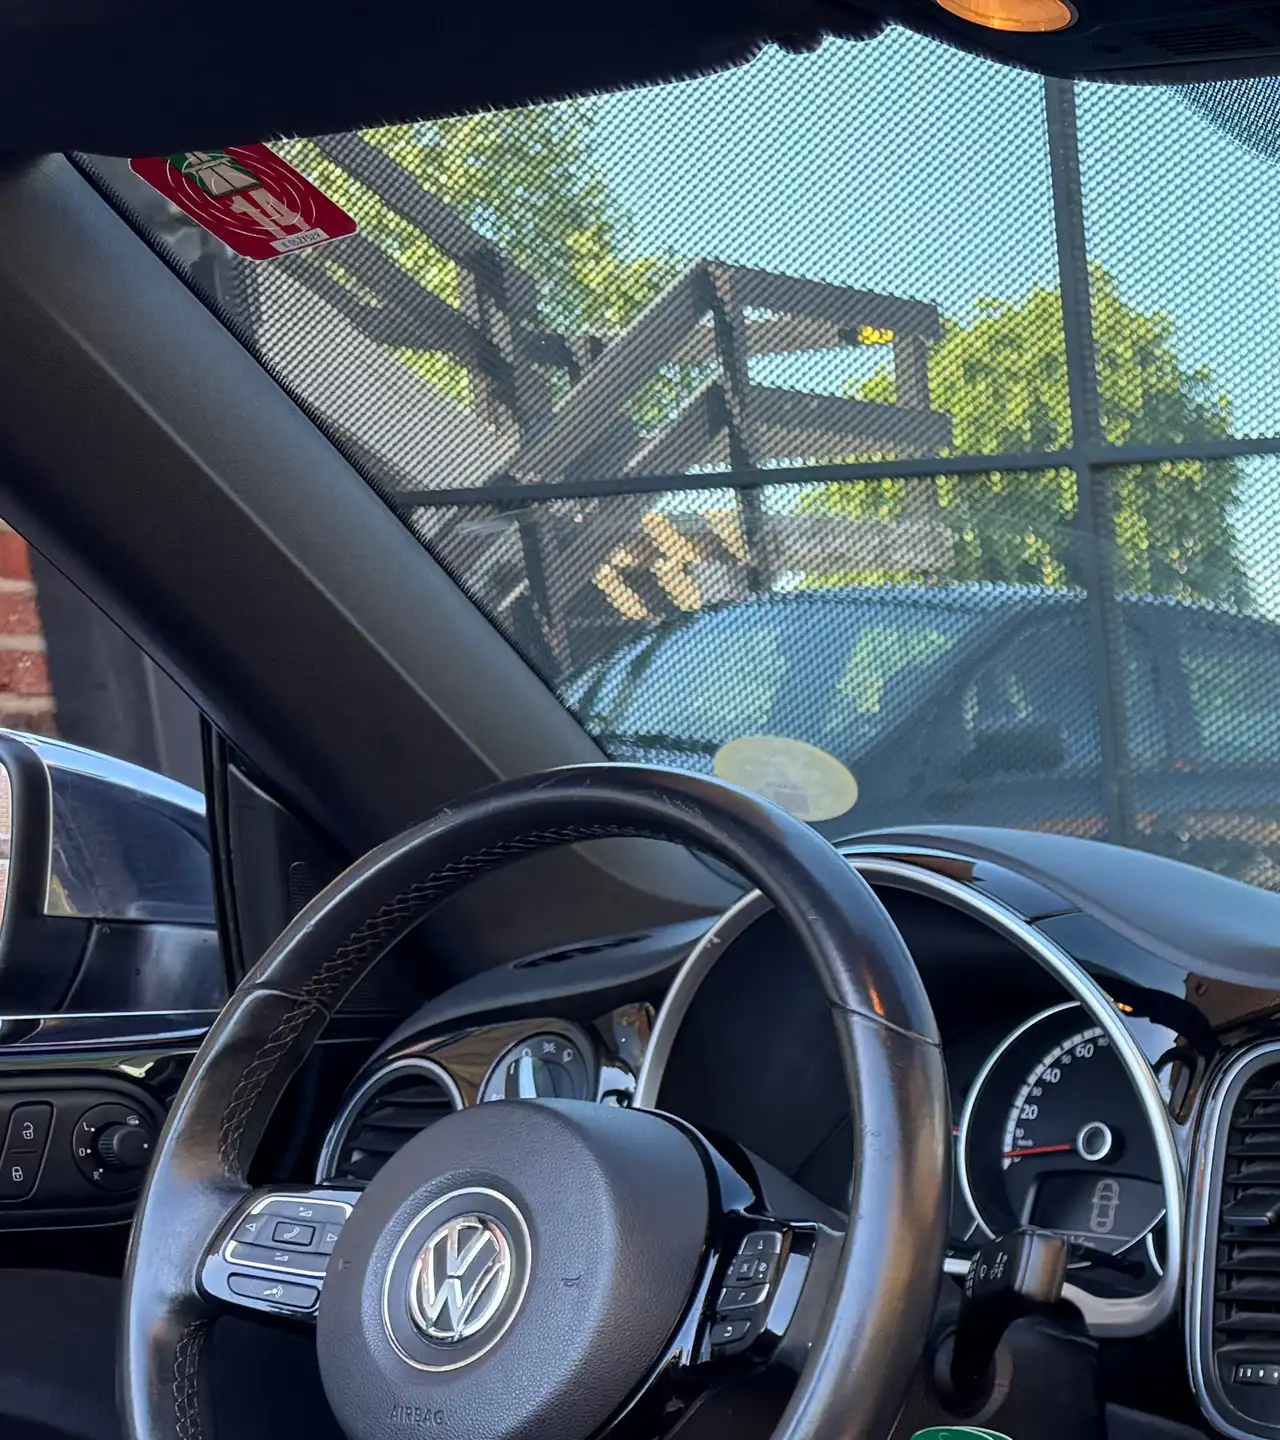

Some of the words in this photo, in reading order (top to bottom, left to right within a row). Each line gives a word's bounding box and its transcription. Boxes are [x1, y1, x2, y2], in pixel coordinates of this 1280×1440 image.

[1075, 1043, 1094, 1058] 60
[1042, 1068, 1061, 1083] 40
[1020, 1104, 1038, 1120] 20
